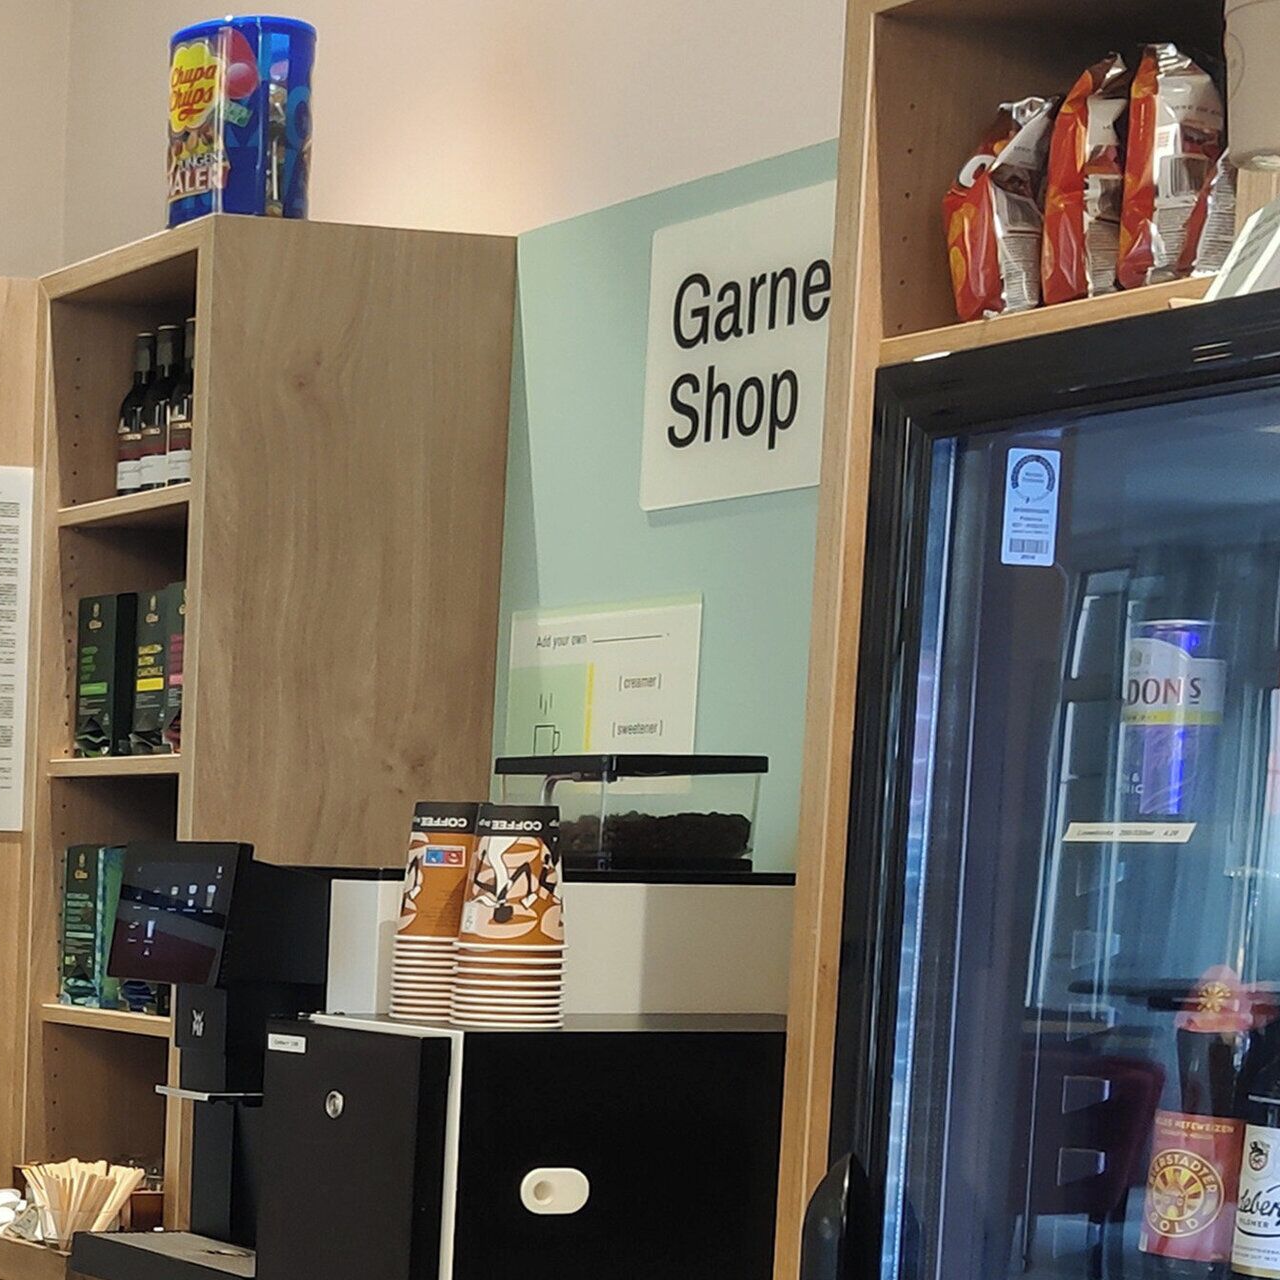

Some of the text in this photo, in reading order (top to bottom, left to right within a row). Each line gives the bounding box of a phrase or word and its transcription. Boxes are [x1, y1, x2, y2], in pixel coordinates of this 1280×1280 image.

[171, 64, 217, 89] Chupa
[170, 83, 214, 111] Chups
[674, 259, 831, 349] Garne
[668, 365, 799, 450] Shop
[536, 634, 587, 650] Add your own
[420, 816, 468, 828] COFFEE
[491, 819, 542, 831] COFFEE
